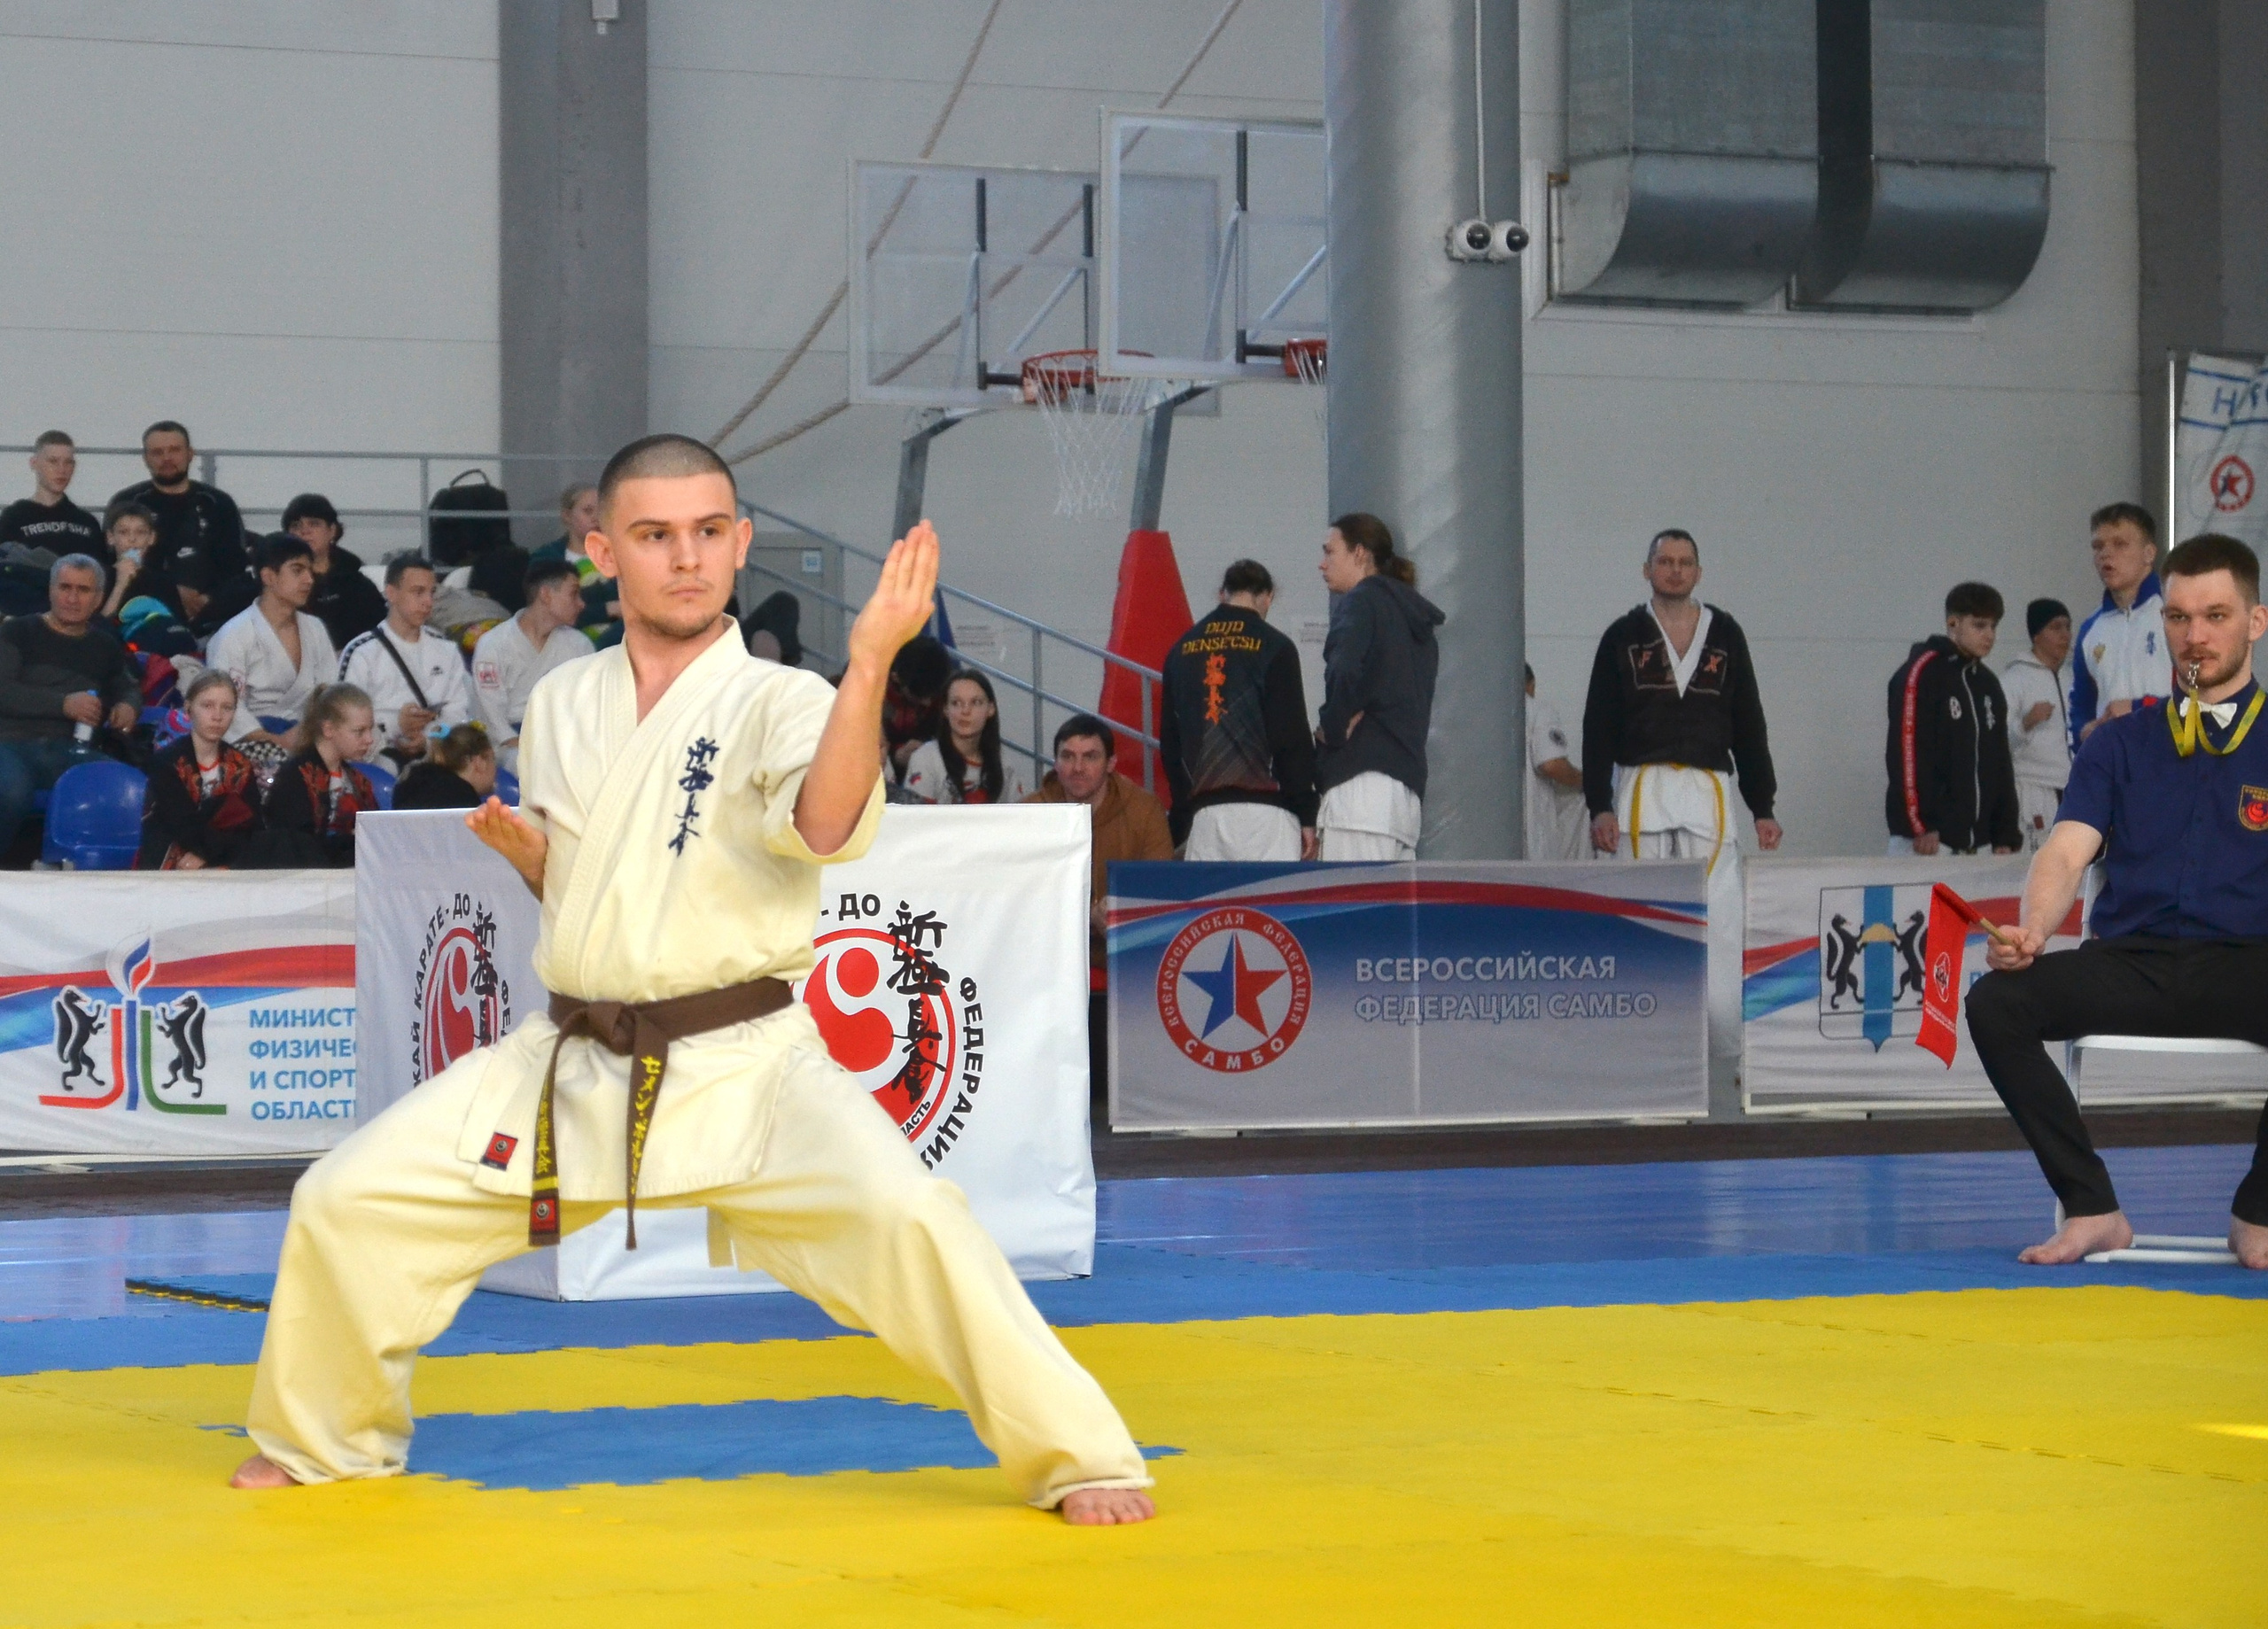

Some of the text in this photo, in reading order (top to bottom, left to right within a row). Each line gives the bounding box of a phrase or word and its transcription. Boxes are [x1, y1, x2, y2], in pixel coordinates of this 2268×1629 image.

[1355, 950, 1616, 982] ВСЕРОССИЙСКАЯ
[249, 1008, 356, 1028] МИНИСТ
[1355, 992, 1658, 1026] ФЕДЕРАЦИЯ САМБО
[249, 1038, 356, 1059] ФИЗИЧЕ
[1184, 1036, 1285, 1070] САМБО
[250, 1068, 356, 1090] И СПОРТ
[251, 1099, 356, 1121] ОБЛАСТ
